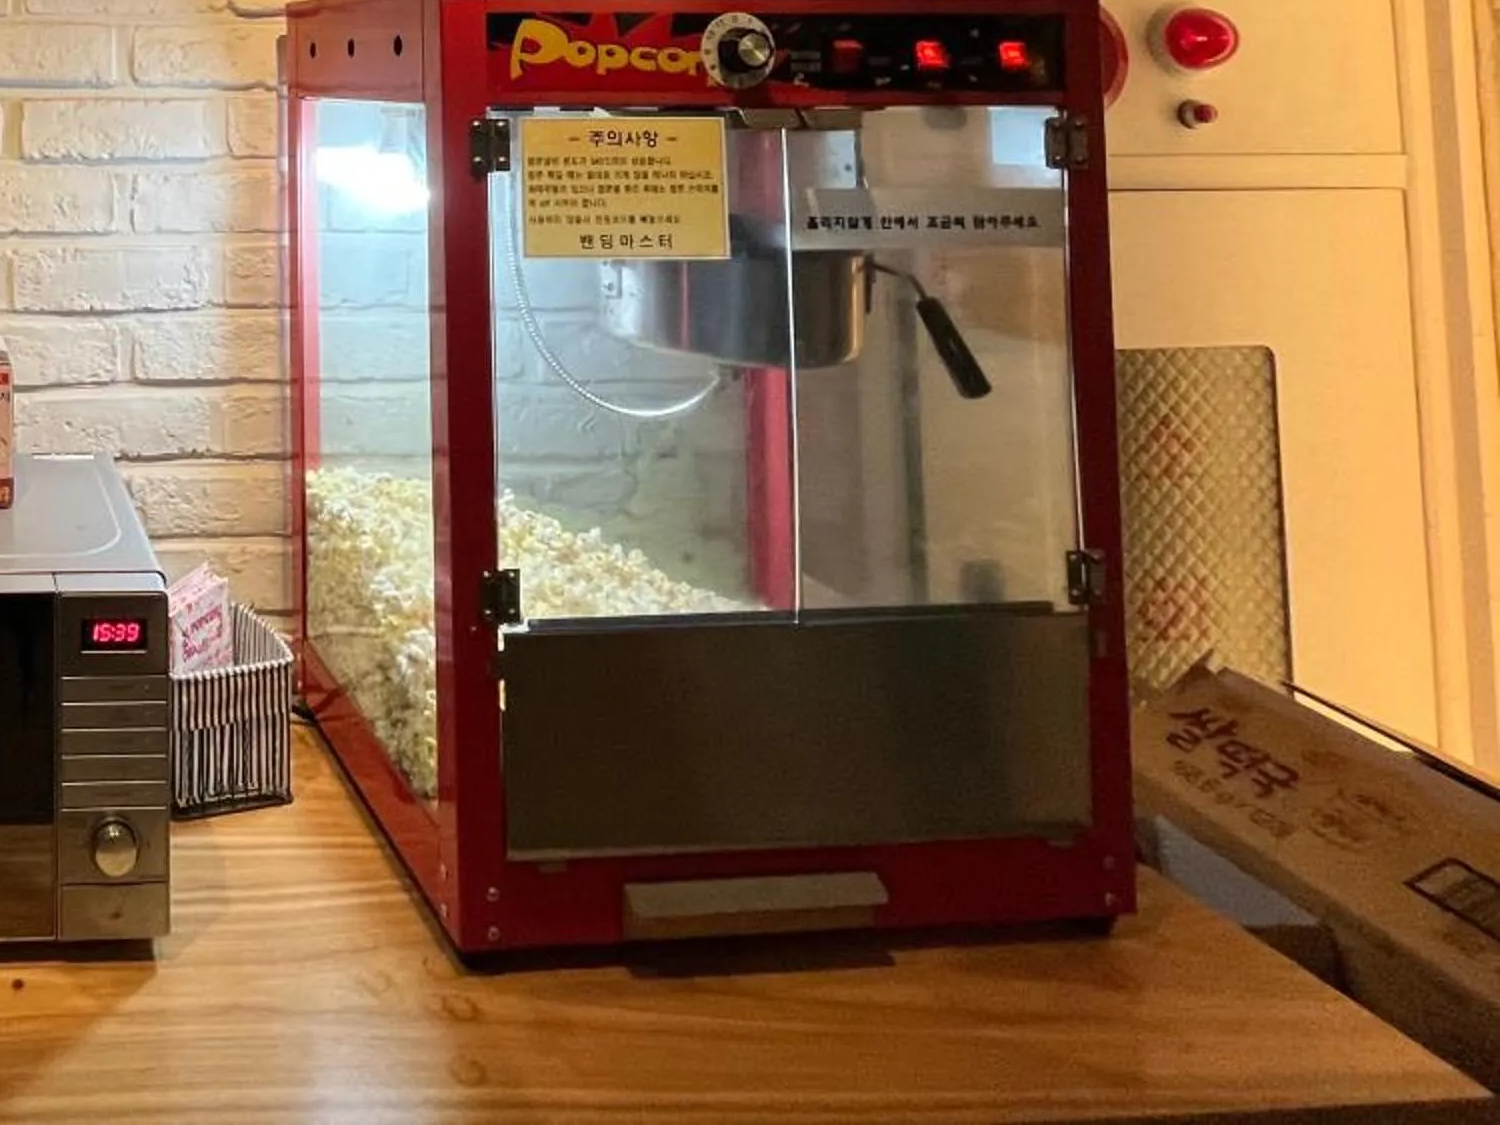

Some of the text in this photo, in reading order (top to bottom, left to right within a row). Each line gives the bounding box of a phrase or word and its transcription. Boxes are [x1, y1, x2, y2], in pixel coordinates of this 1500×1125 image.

[509, 17, 722, 88] Popcor
[587, 130, 659, 148] 주의사항
[880, 216, 919, 230] 안에서
[92, 622, 141, 642] 15:39
